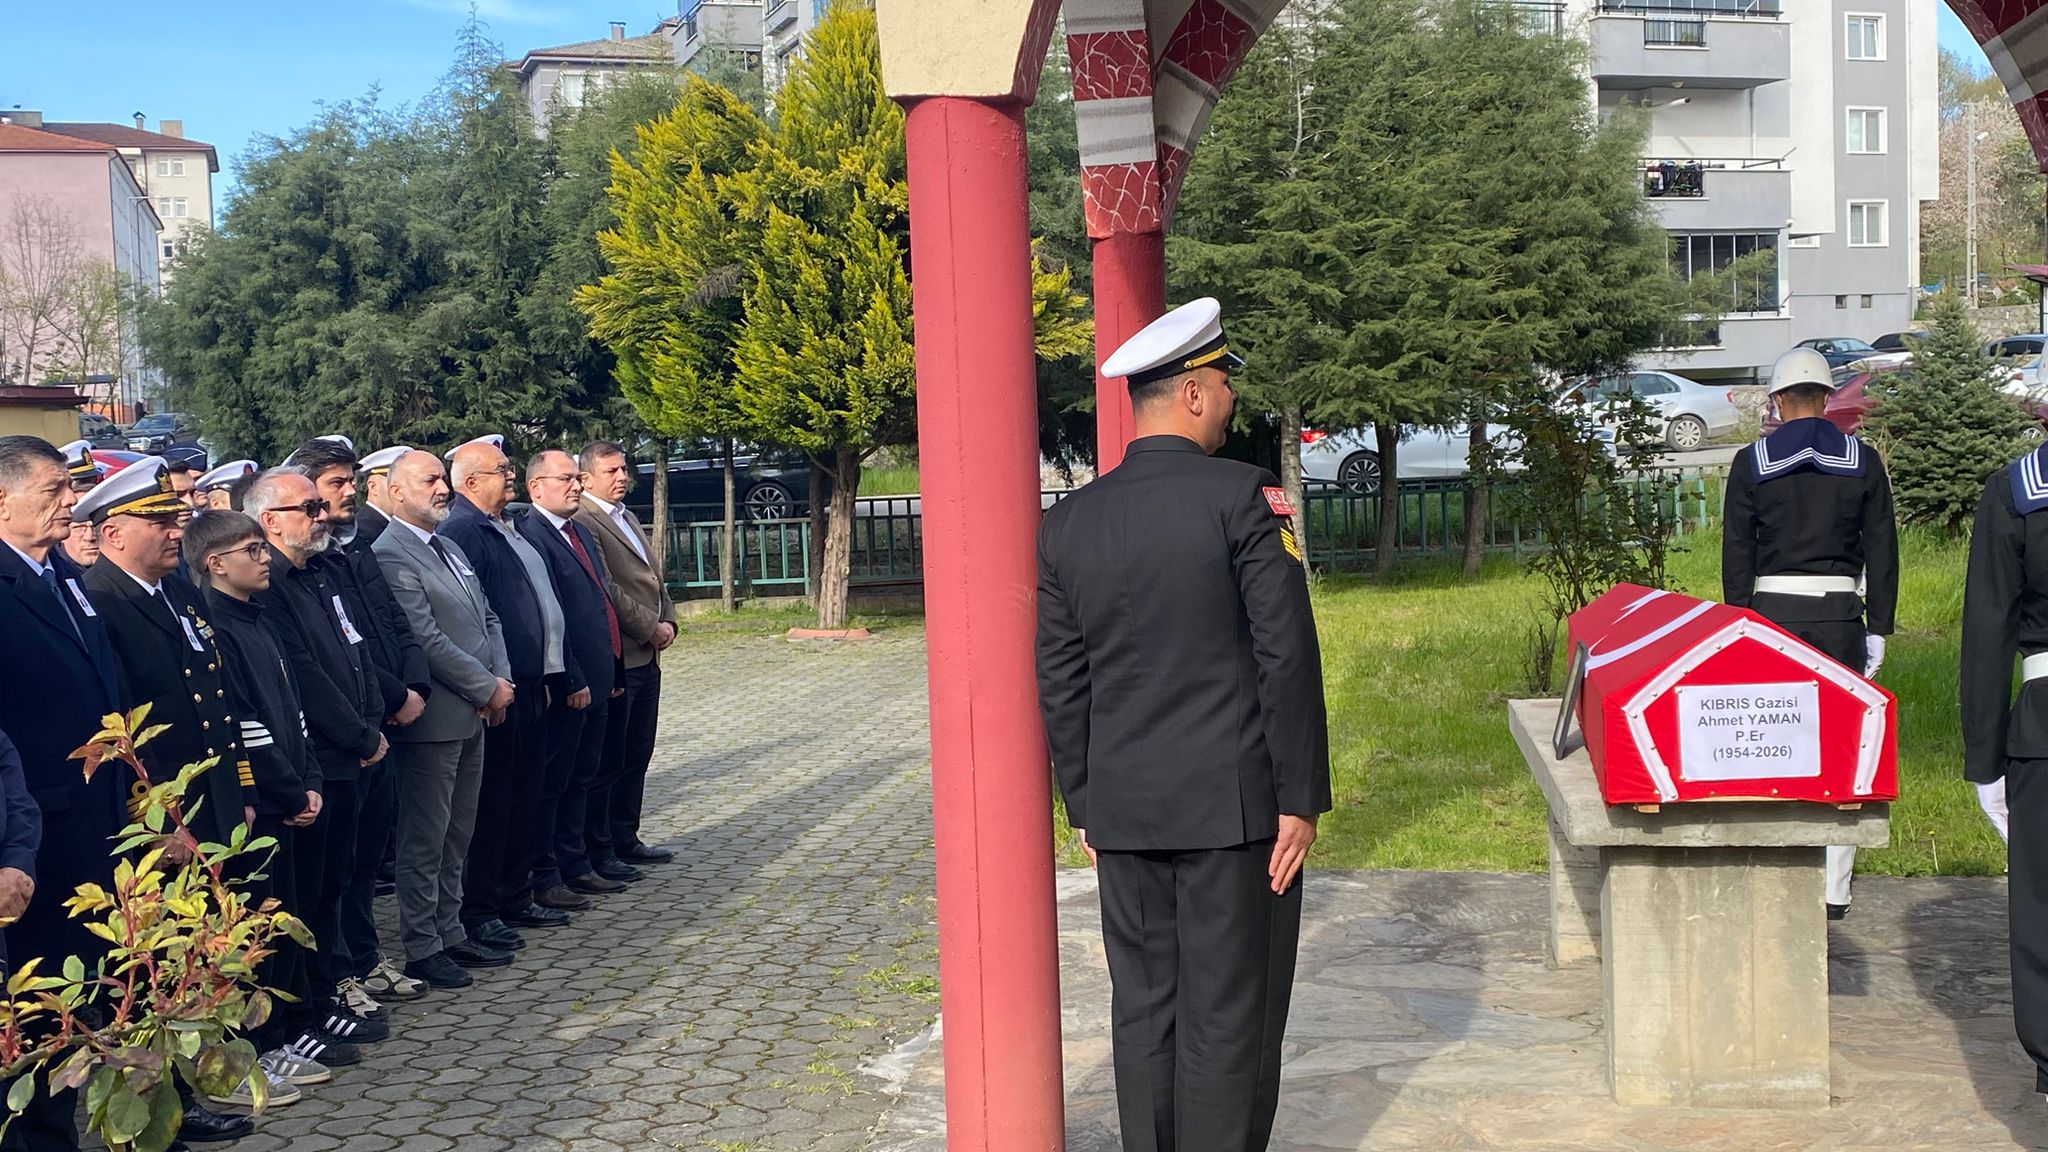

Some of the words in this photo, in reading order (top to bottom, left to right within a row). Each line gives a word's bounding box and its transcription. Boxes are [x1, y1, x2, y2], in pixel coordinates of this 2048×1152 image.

[1700, 698, 1750, 711] KIBRIS
[1754, 697, 1798, 709] Gazisi
[1698, 715, 1743, 727] Ahmet
[1748, 713, 1801, 726] YAMAN
[1735, 730, 1765, 742] P.Er
[1713, 745, 1792, 761] (1954-2026)
